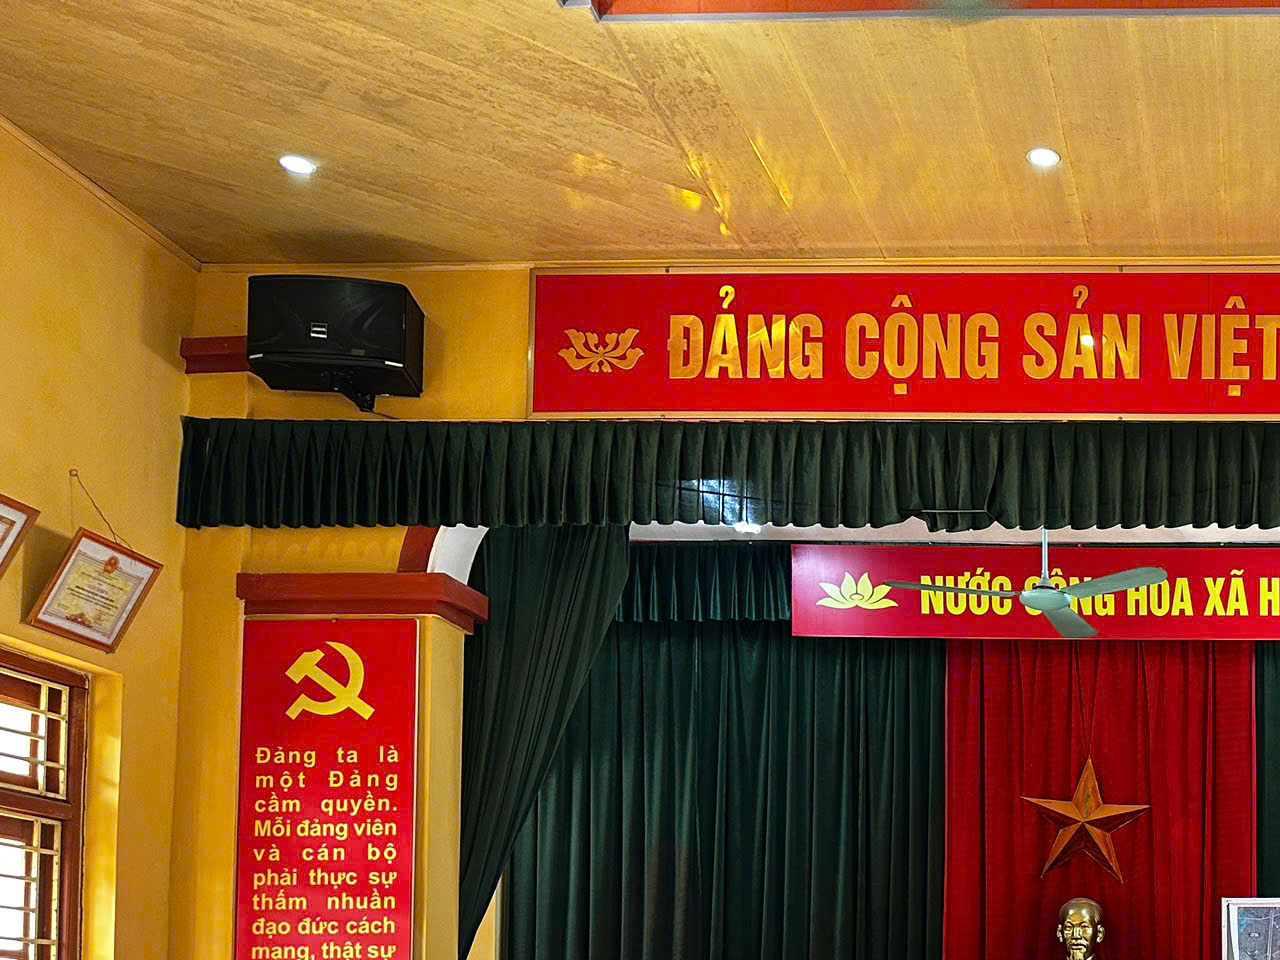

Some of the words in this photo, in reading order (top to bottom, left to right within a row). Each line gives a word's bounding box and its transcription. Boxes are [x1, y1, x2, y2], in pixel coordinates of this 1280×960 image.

[666, 284, 824, 380] ĐẢNG
[844, 294, 1000, 396] CỘNG
[1022, 284, 1141, 380] SẢN
[920, 566, 1013, 616] NƯỚC
[1203, 568, 1250, 617] XÃ
[255, 746, 317, 769] Đảng
[336, 746, 358, 764] ta
[379, 744, 399, 764] là
[255, 770, 306, 793] một
[327, 769, 399, 792] Đảng
[254, 791, 301, 813] cầm
[320, 790, 398, 817] quyền.
[254, 816, 292, 838] Mỗi
[296, 818, 349, 841] đảng
[352, 817, 397, 837] viên
[252, 843, 281, 862] và
[301, 842, 346, 862] cán
[367, 842, 398, 865] bộ
[253, 867, 298, 891] phải
[308, 867, 358, 890] thực
[368, 871, 398, 889] sự
[251, 888, 308, 911] thấm
[327, 887, 396, 910] nhuần
[251, 917, 292, 940] đạo
[297, 916, 340, 935] đức
[345, 915, 396, 935] cách
